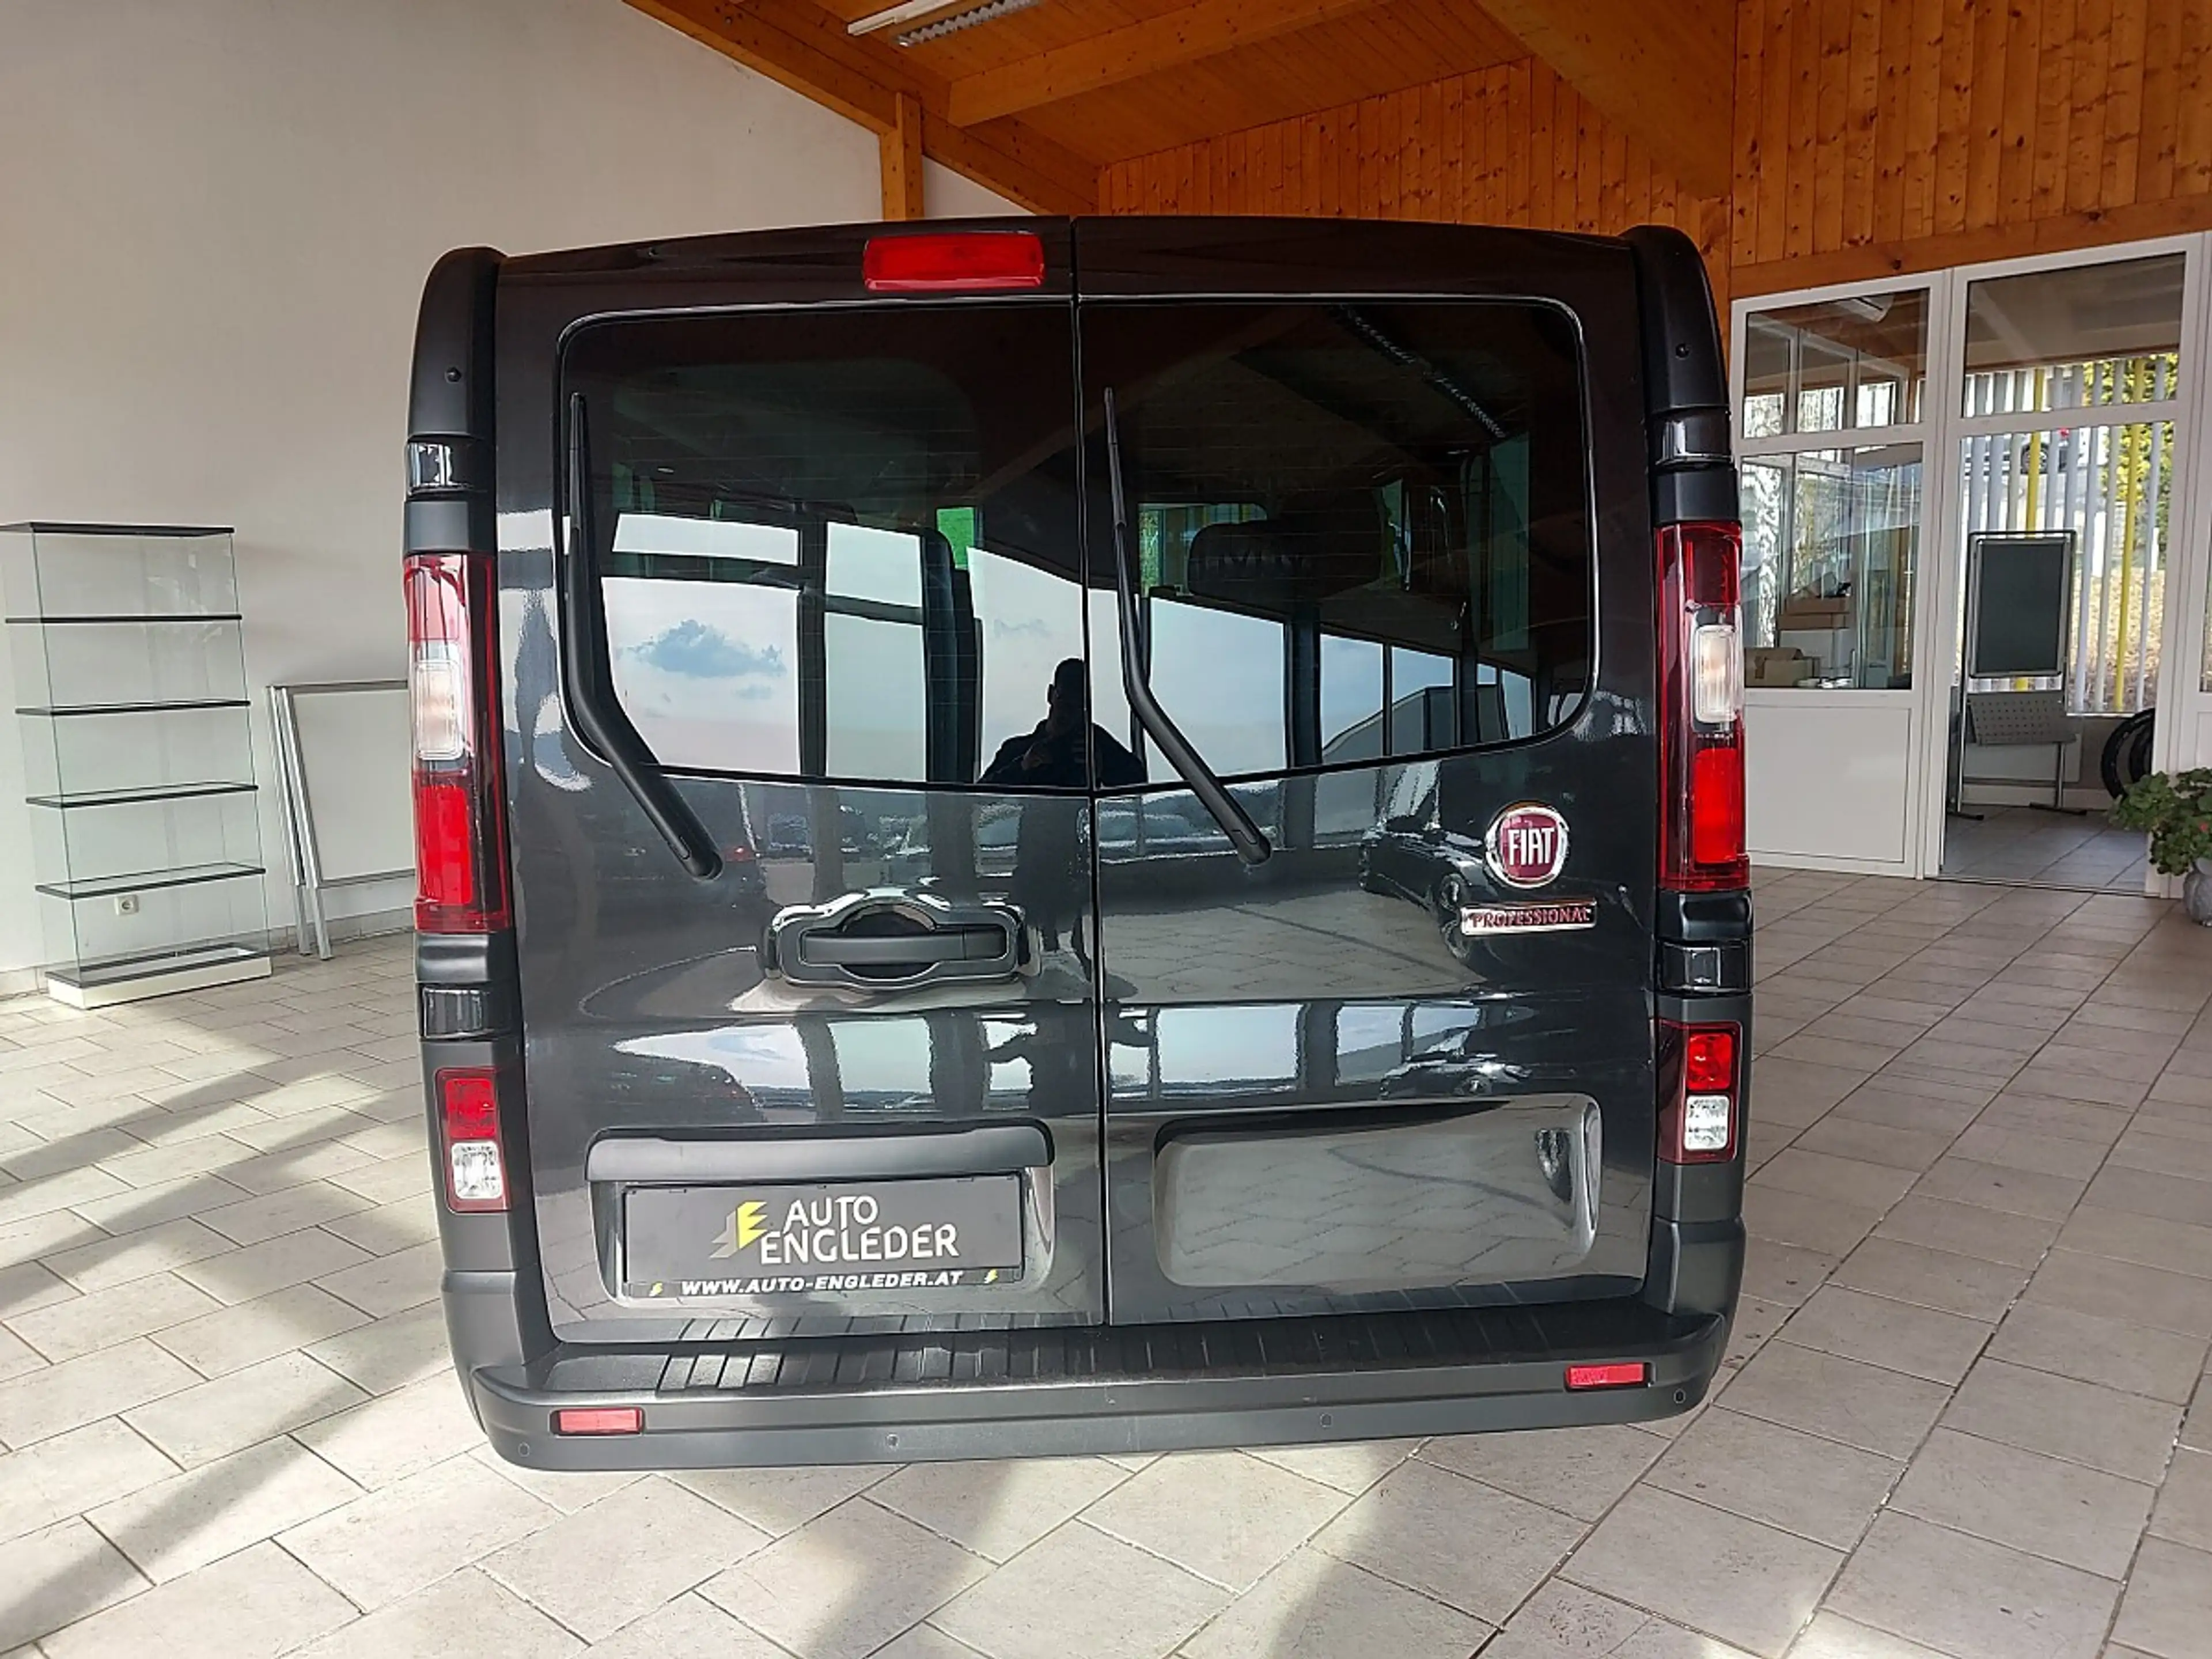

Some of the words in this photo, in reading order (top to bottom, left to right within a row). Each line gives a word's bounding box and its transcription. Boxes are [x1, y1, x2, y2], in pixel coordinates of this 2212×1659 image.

[1508, 828, 1554, 865] FIAT
[1471, 907, 1590, 927] PROFESSIONAL
[783, 1196, 878, 1232] AUTO
[760, 1224, 960, 1265] ENGLEDER
[681, 1271, 963, 1296] WWW.AUTO-ENGLEDER.AT
